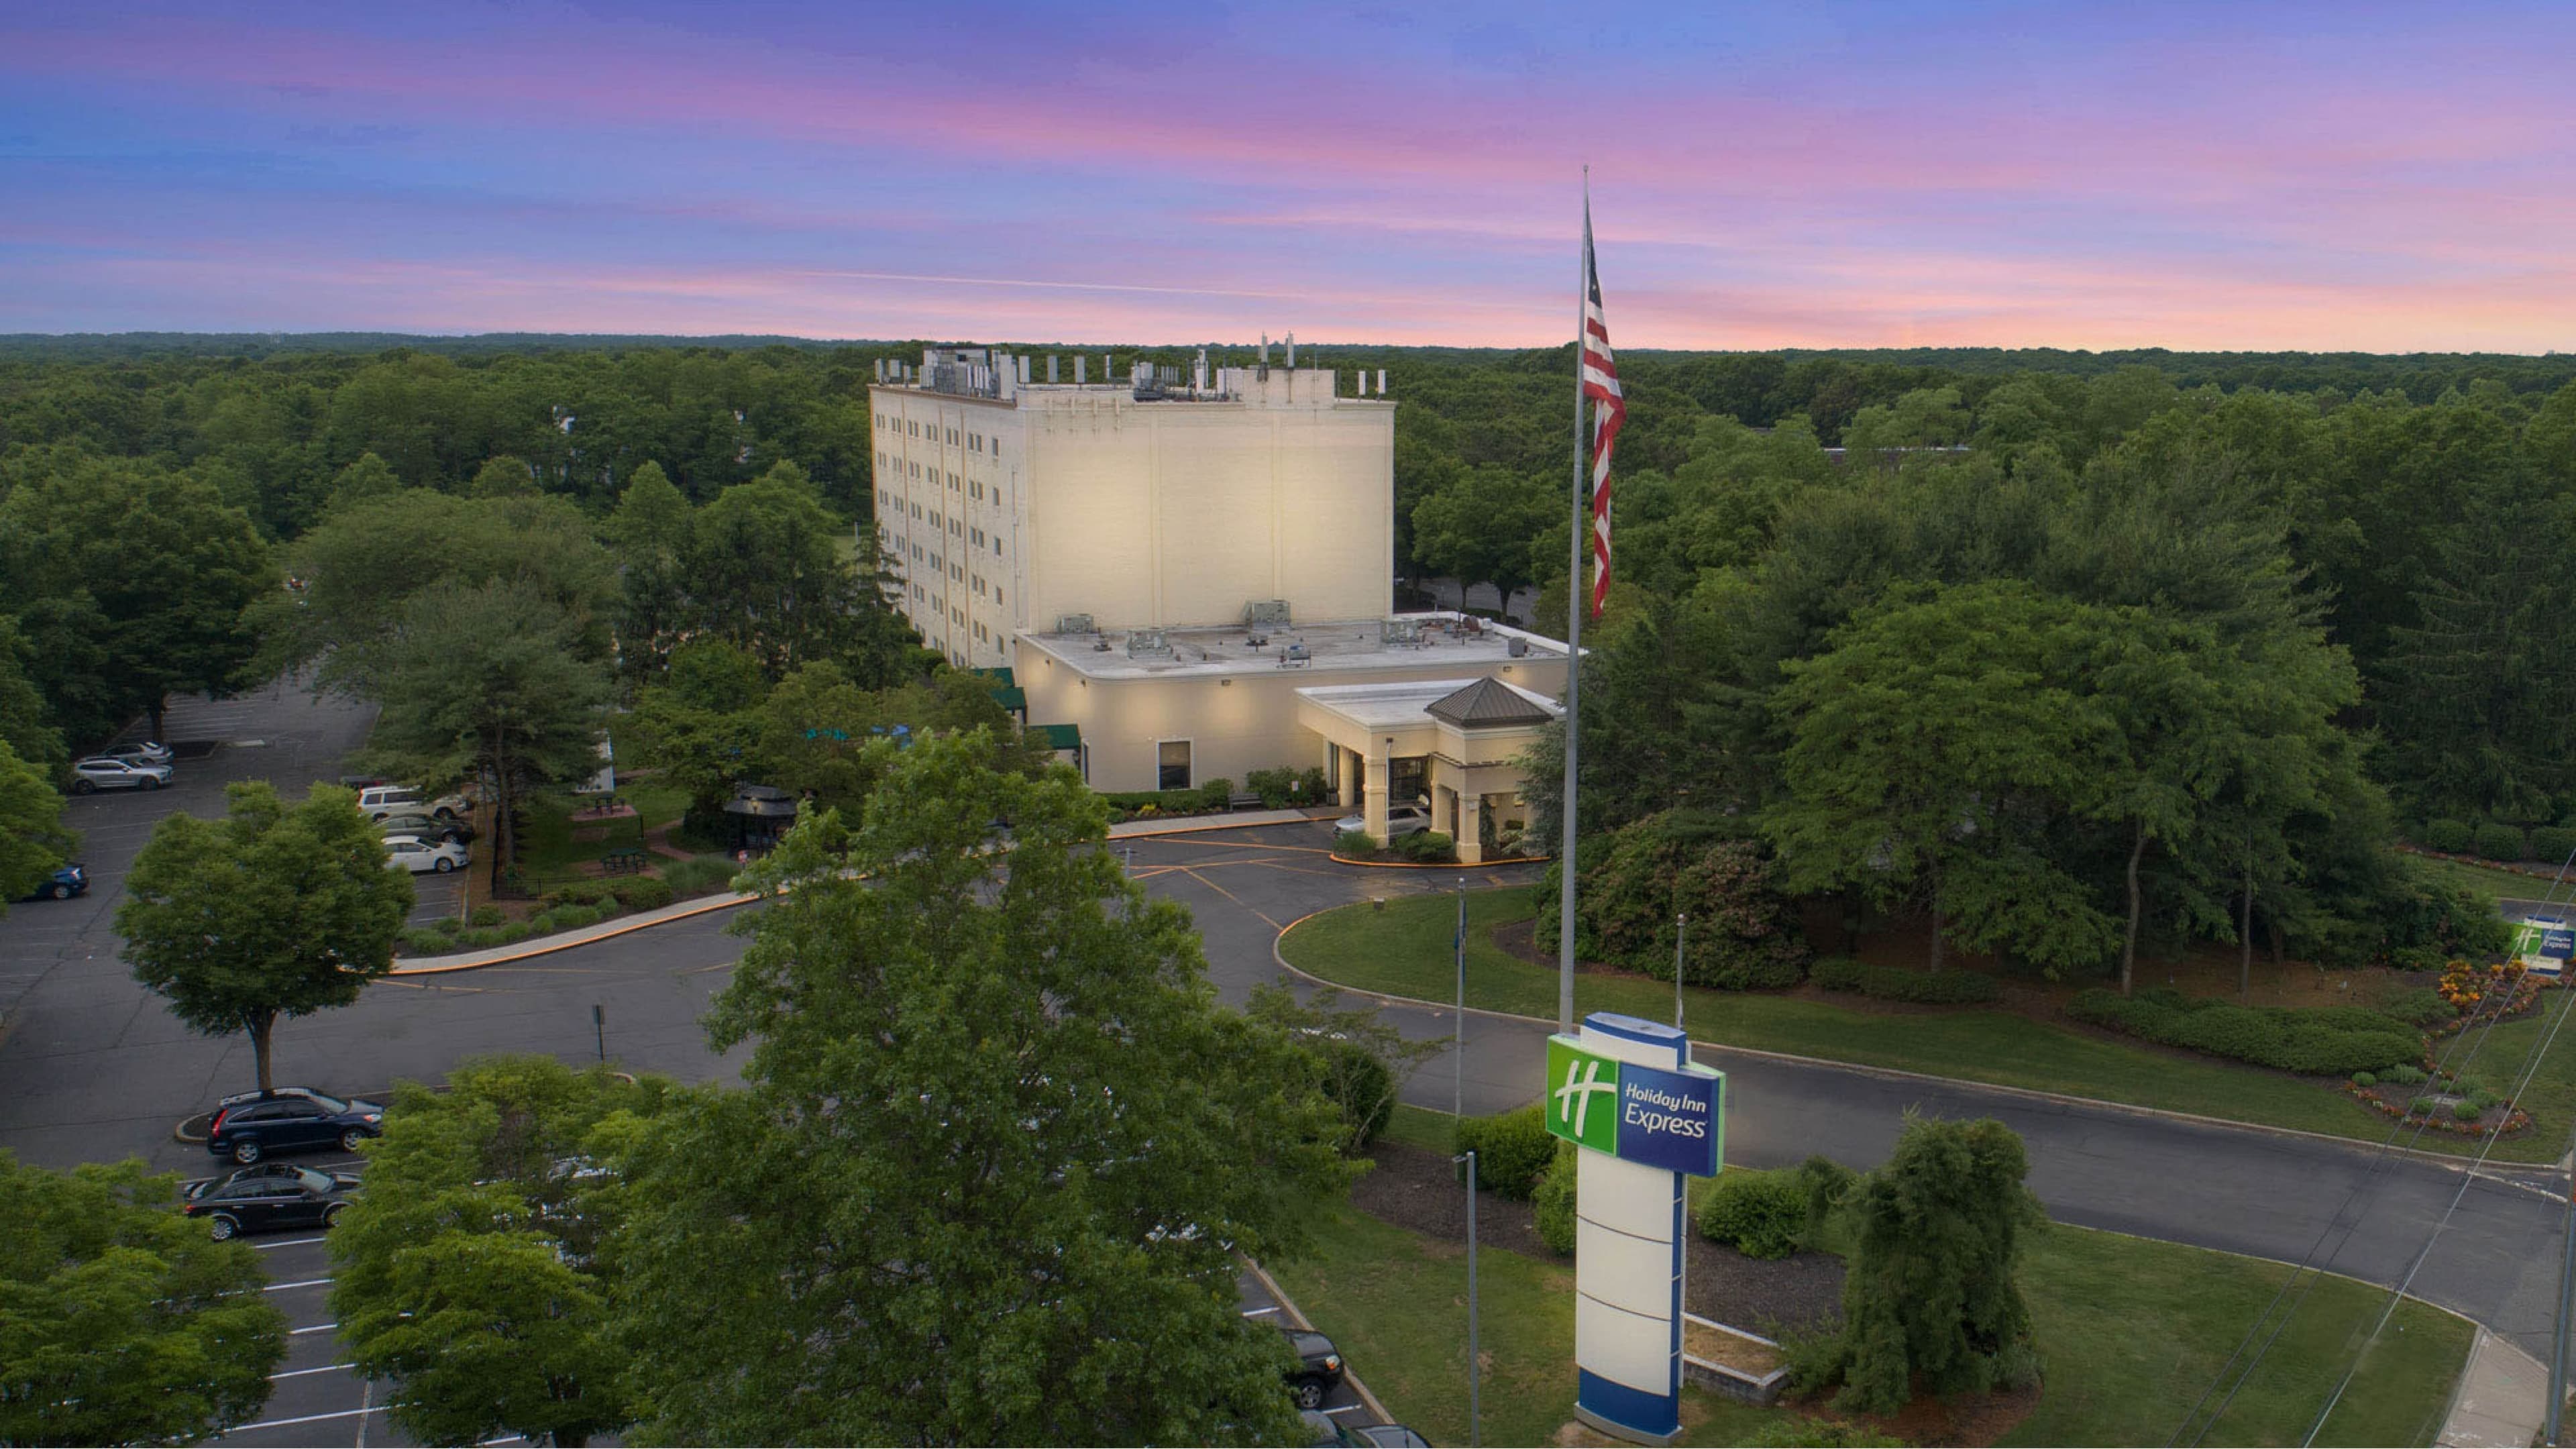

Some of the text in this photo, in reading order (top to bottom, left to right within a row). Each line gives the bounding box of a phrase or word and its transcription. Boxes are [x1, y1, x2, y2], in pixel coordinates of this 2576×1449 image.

[1625, 1083, 1706, 1112] Holiday Inn
[1625, 1103, 1705, 1138] Express
